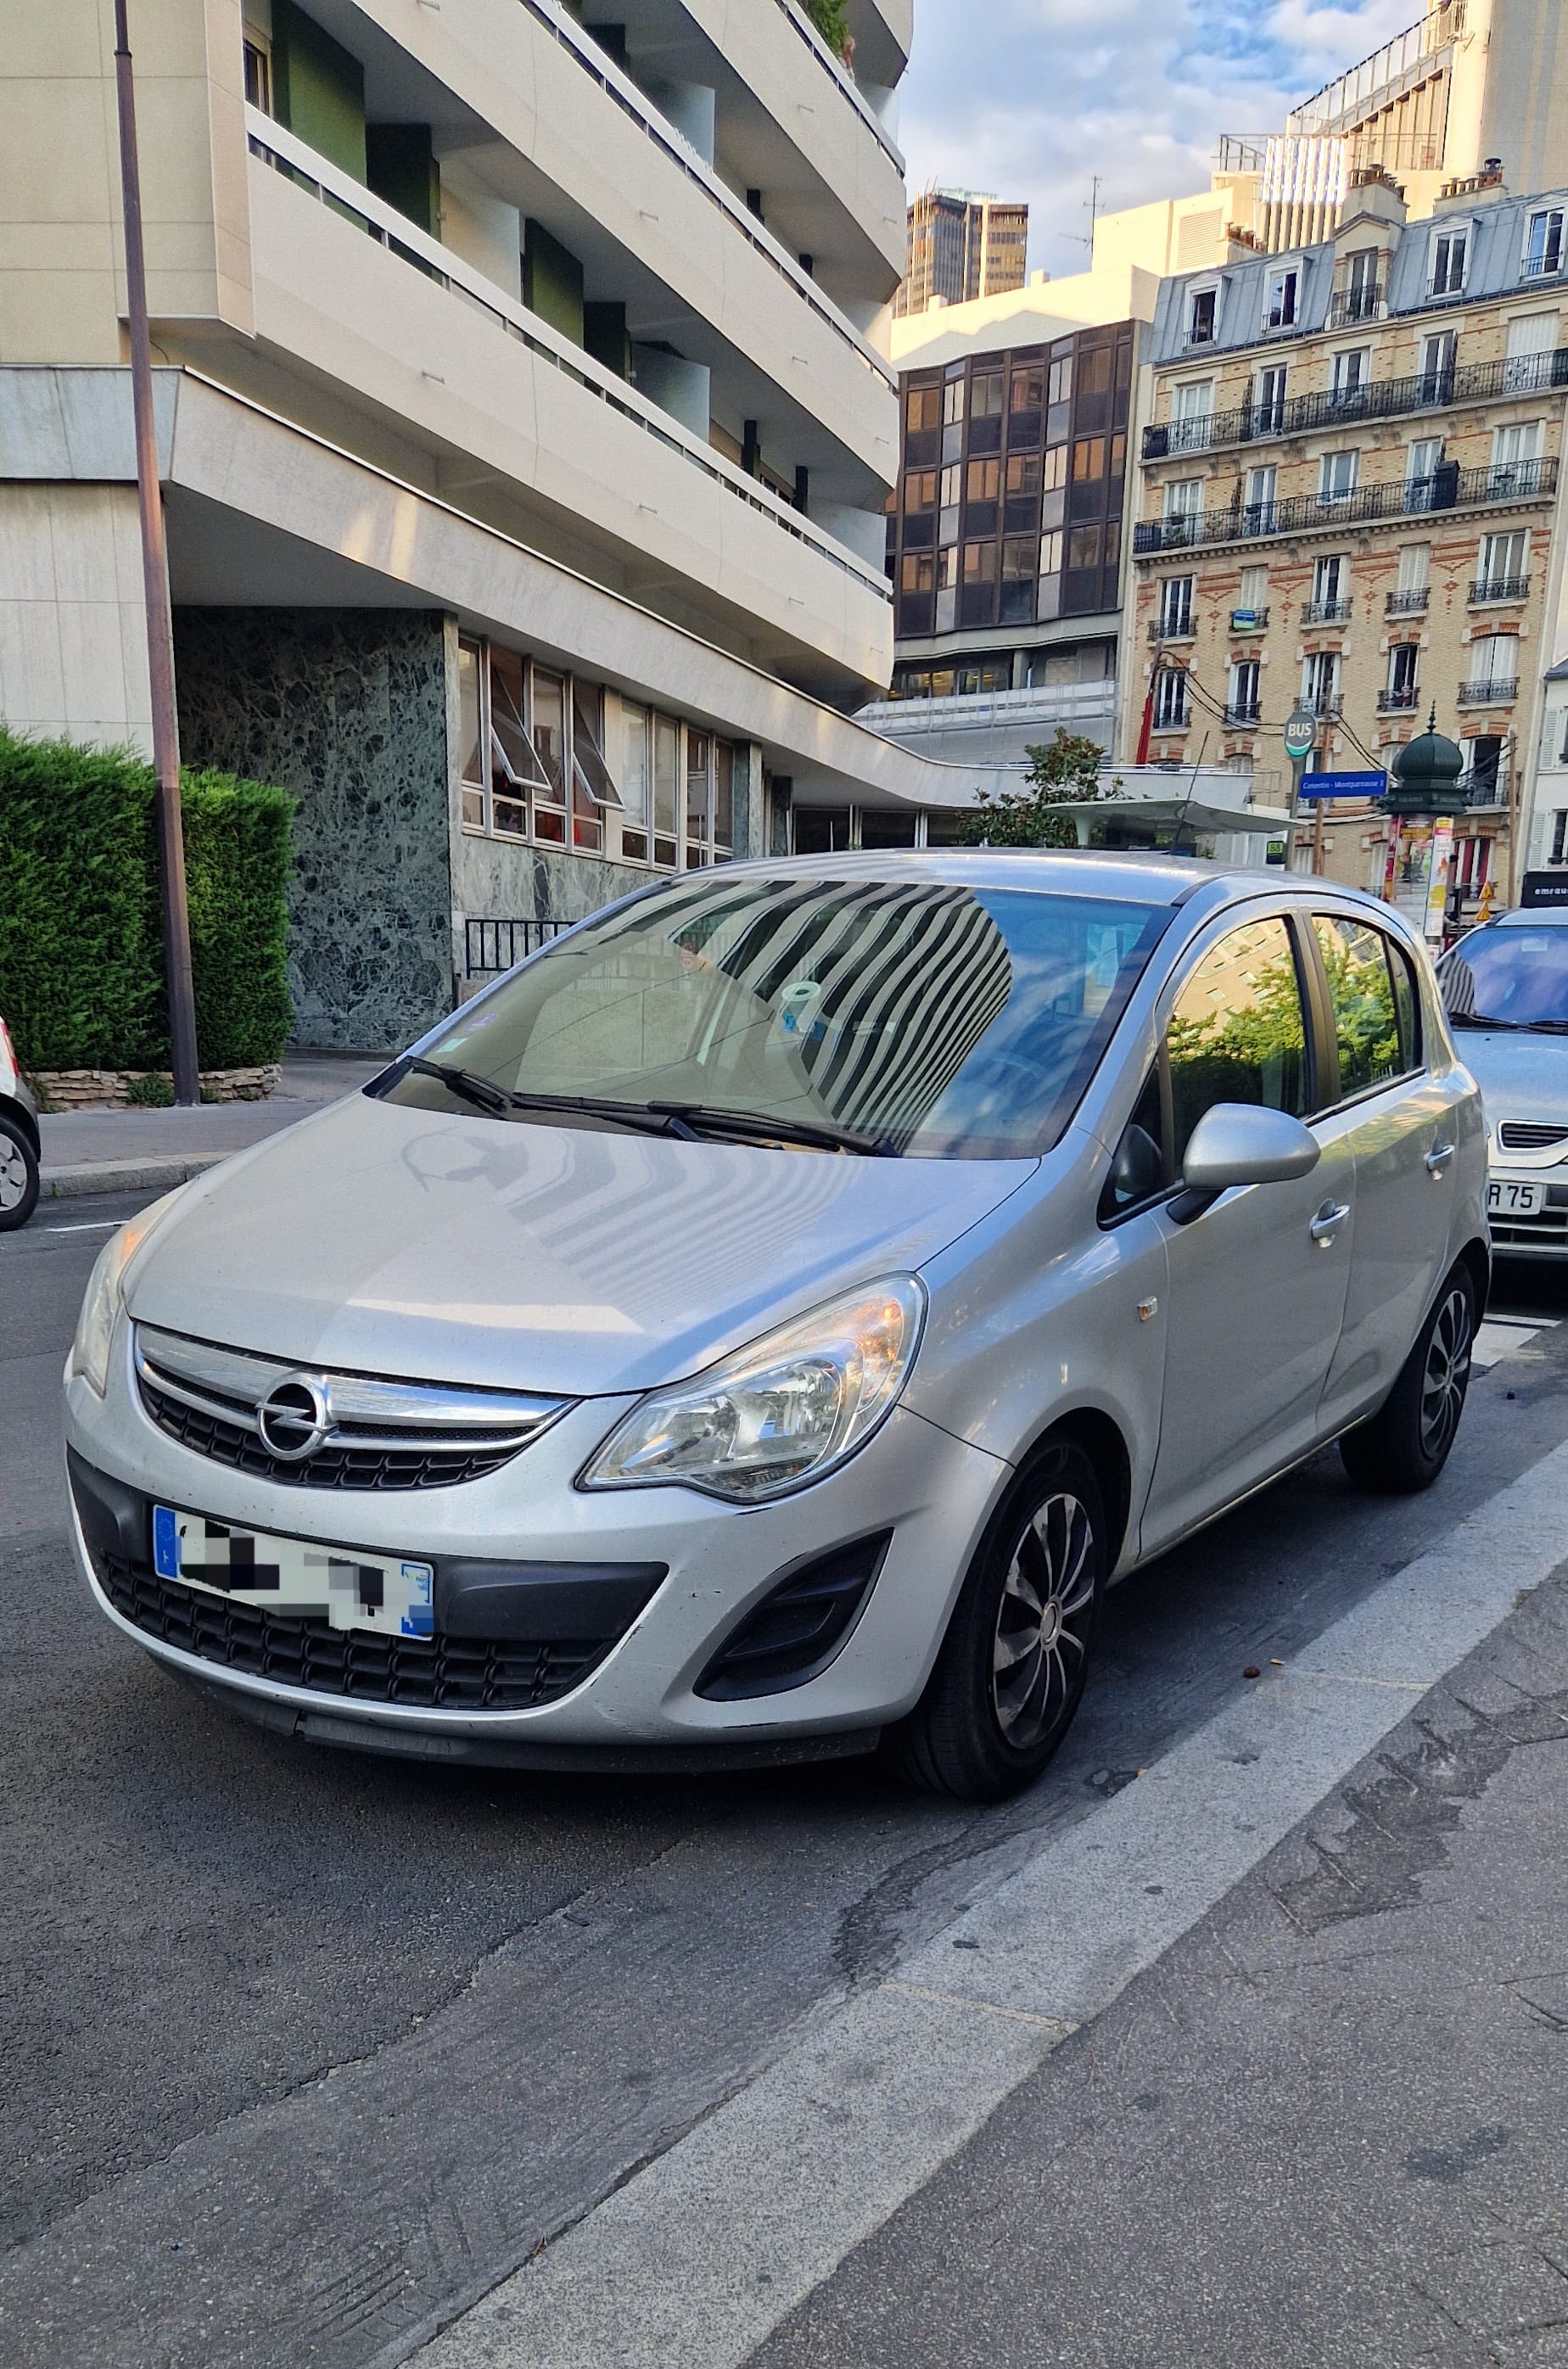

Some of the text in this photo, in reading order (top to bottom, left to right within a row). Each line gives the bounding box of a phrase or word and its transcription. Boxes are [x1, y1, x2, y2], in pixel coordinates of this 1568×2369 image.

[1288, 722, 1312, 737] BUS
[1335, 780, 1379, 789] Montparnasse
[1507, 1184, 1534, 1208] 75
